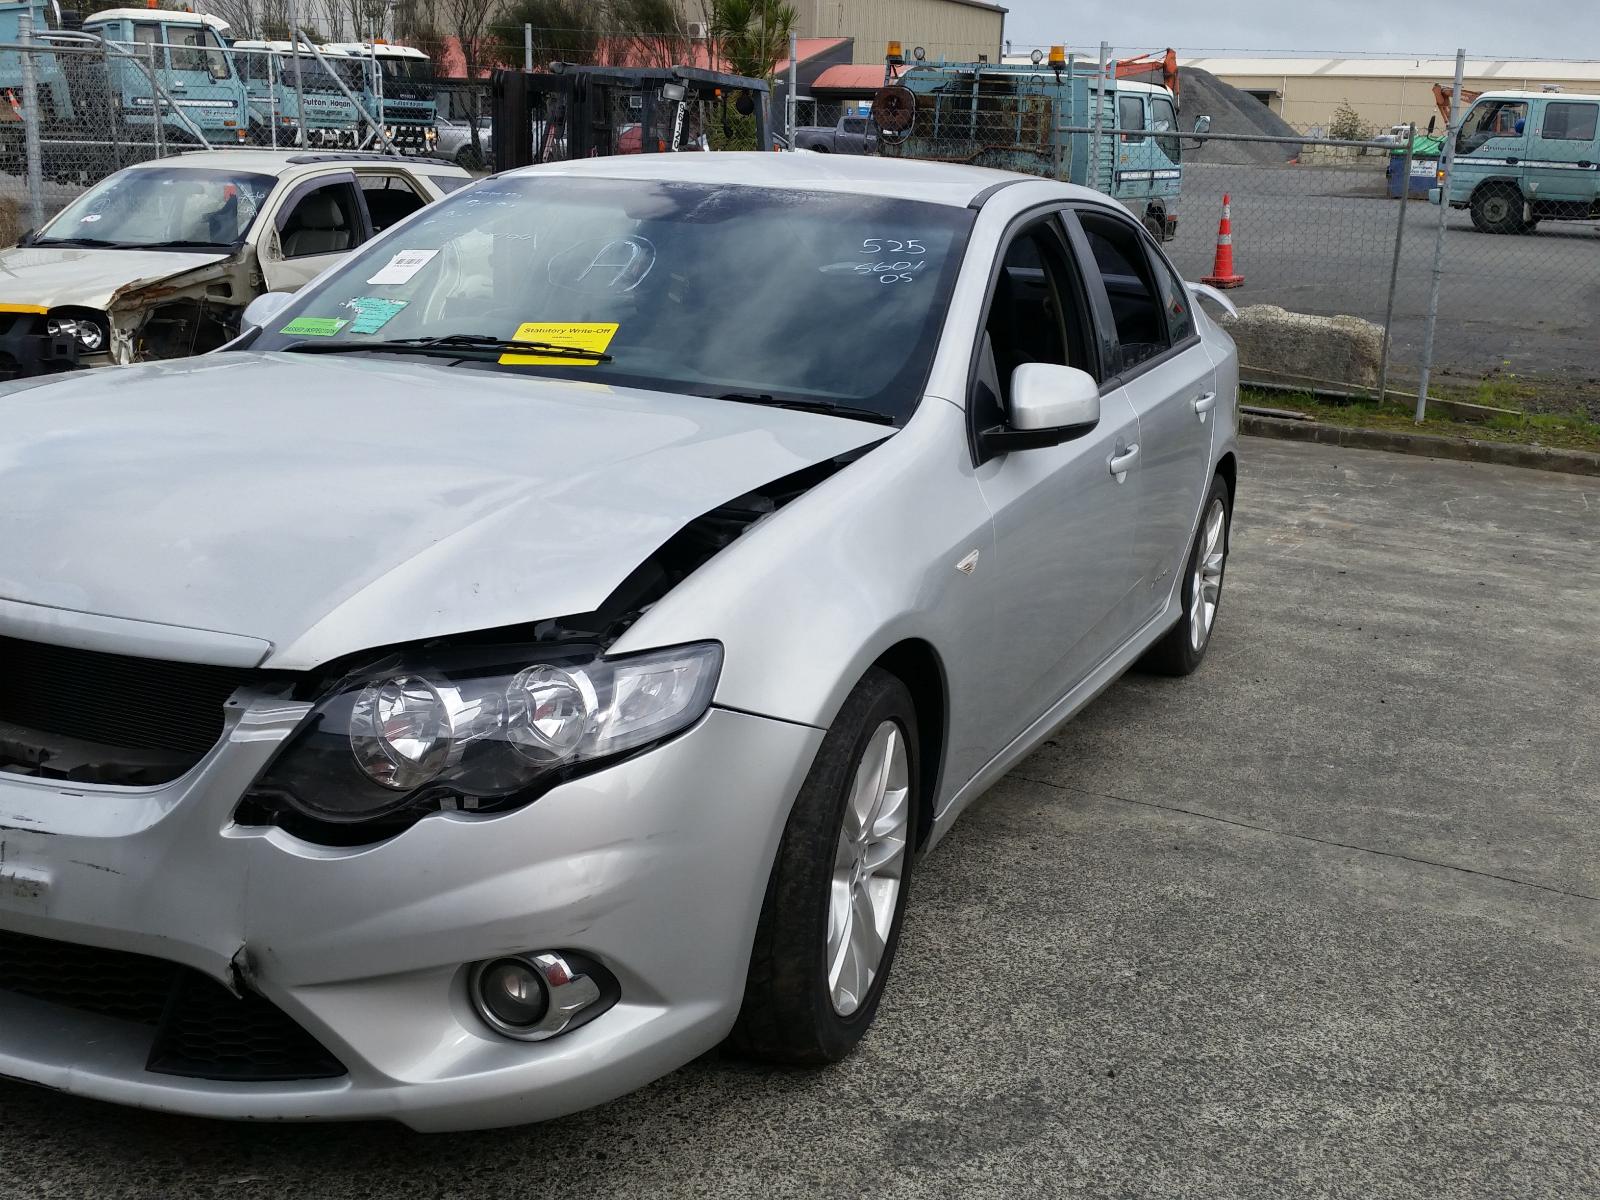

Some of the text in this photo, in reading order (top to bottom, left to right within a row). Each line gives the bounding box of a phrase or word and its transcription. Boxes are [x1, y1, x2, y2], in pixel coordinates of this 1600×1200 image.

[330, 99, 351, 109] Hogan
[859, 238, 926, 255] 525
[523, 327, 611, 335] Statutory Write-Off
